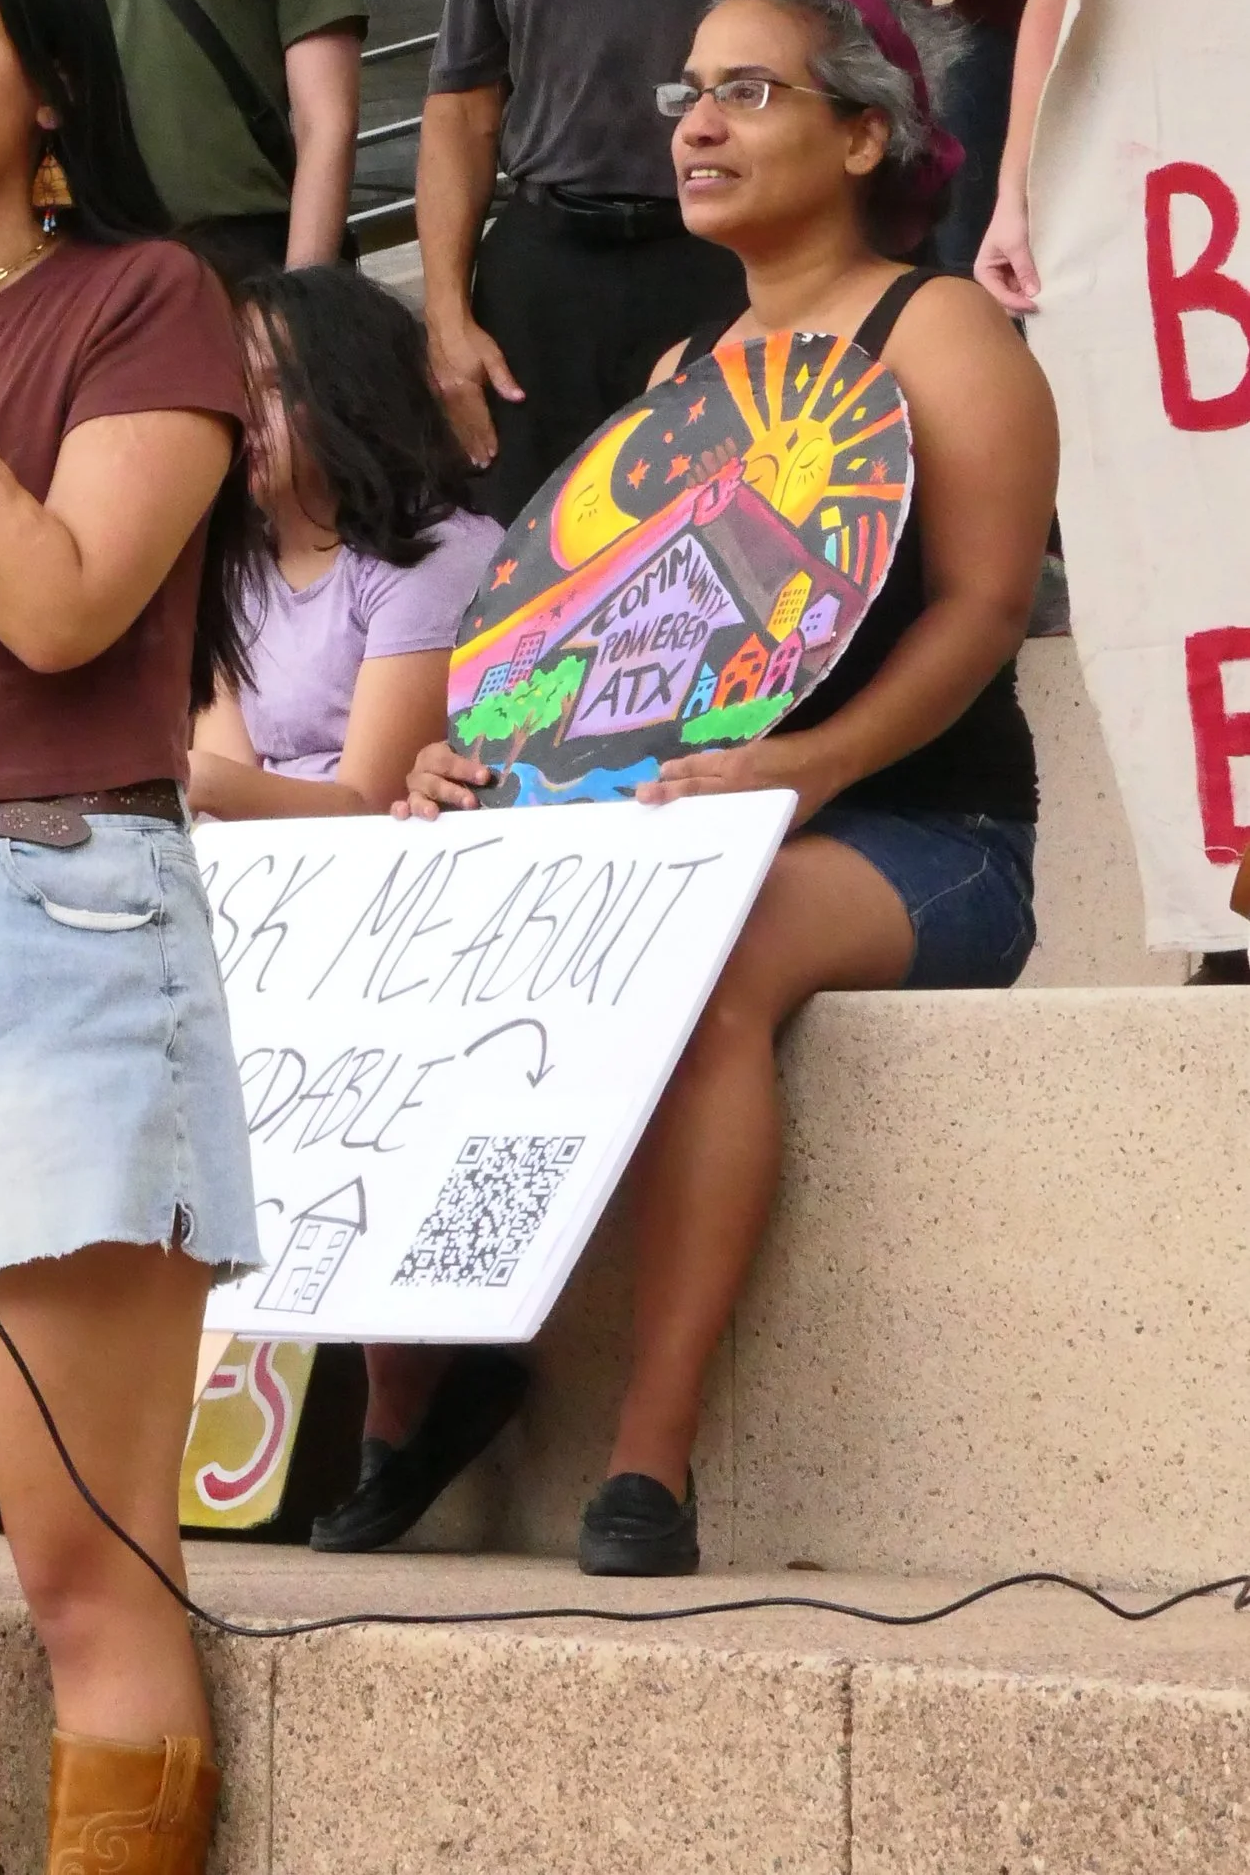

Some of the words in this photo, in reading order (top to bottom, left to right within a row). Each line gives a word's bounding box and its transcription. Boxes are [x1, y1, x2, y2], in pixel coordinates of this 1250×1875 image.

[591, 538, 732, 637] COMMUNITY
[600, 610, 709, 666] POWERED
[579, 658, 687, 722] ATX
[306, 836, 504, 1005] ME
[428, 852, 724, 1007] ABOUT
